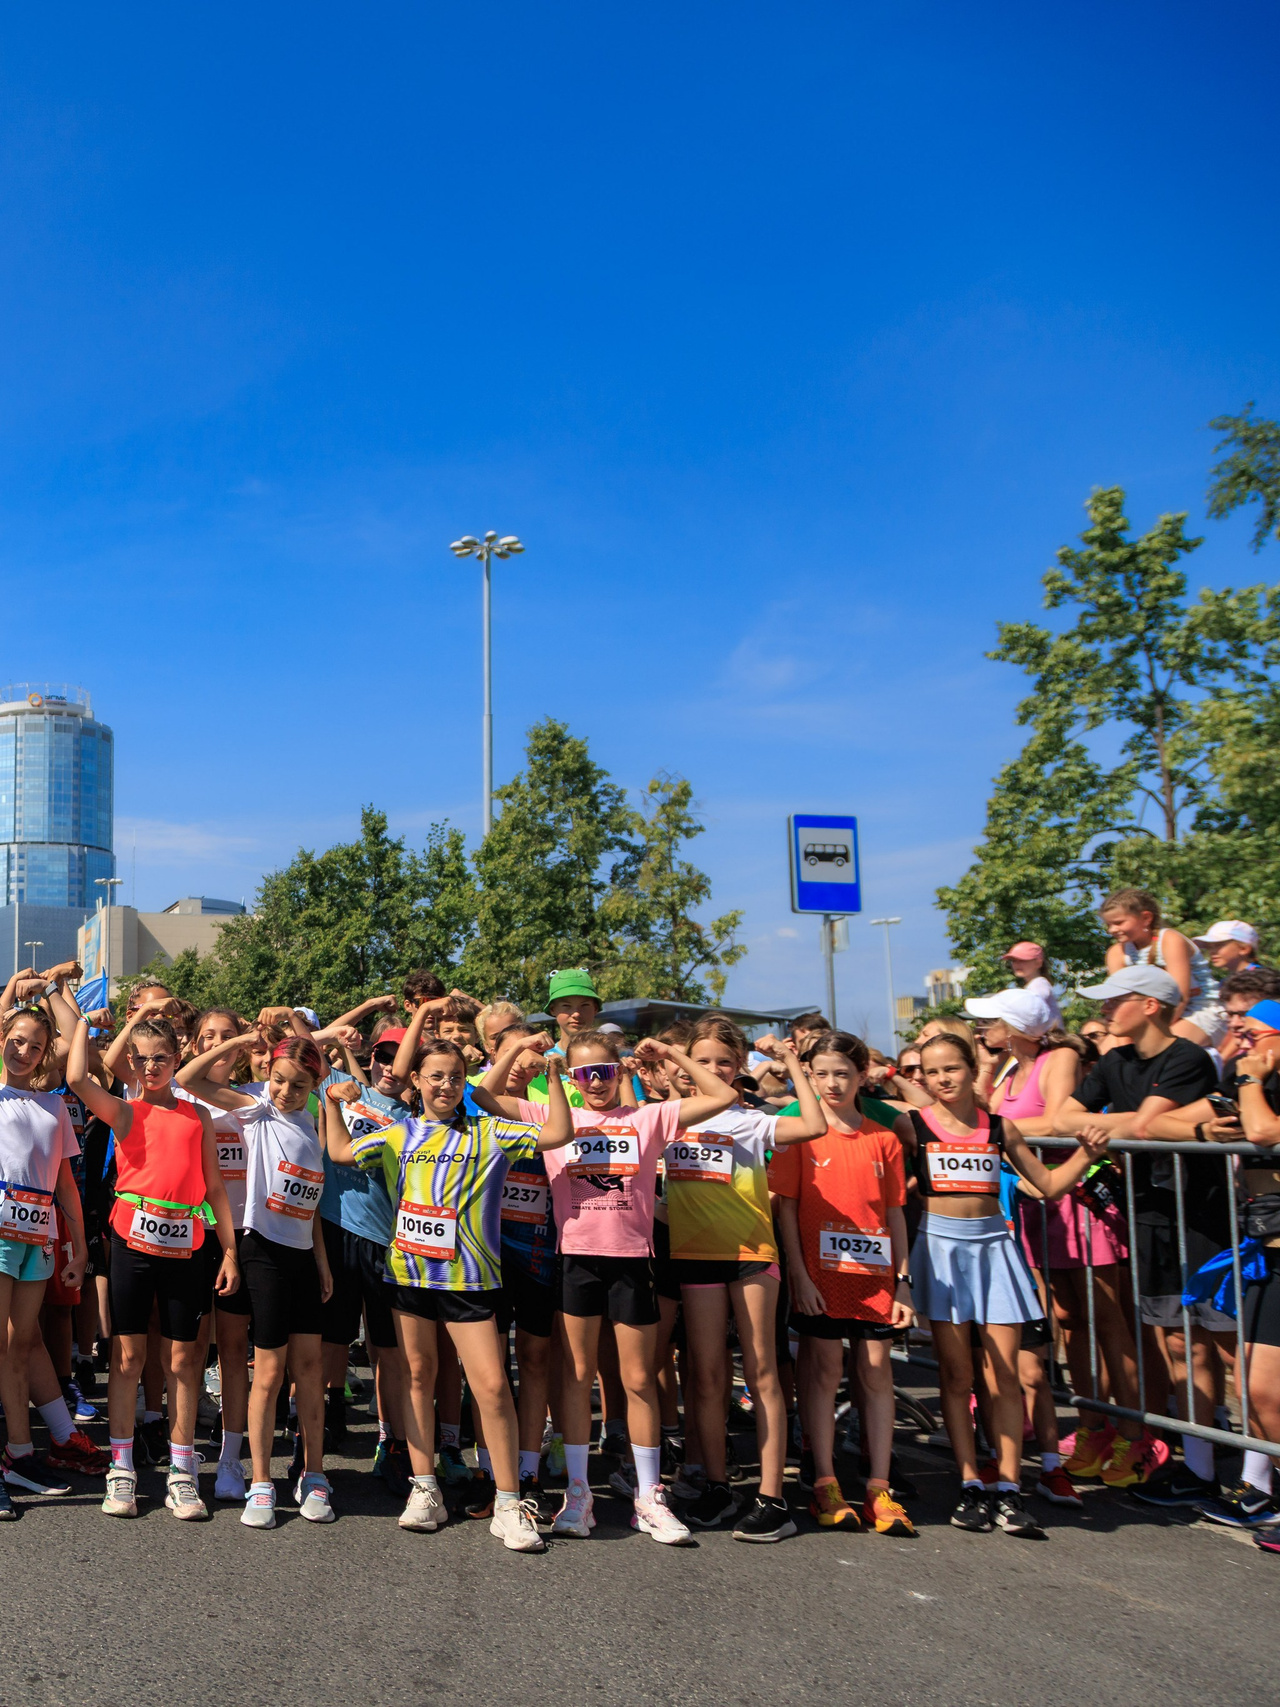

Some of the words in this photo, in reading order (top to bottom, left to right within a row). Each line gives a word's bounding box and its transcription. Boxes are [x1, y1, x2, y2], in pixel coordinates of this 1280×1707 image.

[347, 1115, 382, 1135] 103
[571, 1140, 630, 1155] 10469
[673, 1146, 723, 1163] 10392
[397, 1153, 480, 1166] МАРАФОН
[937, 1157, 994, 1172] 10410
[283, 1179, 320, 1201] 10196
[140, 1216, 188, 1238] 10022
[402, 1216, 445, 1237] 10166
[829, 1236, 883, 1256] 10372
